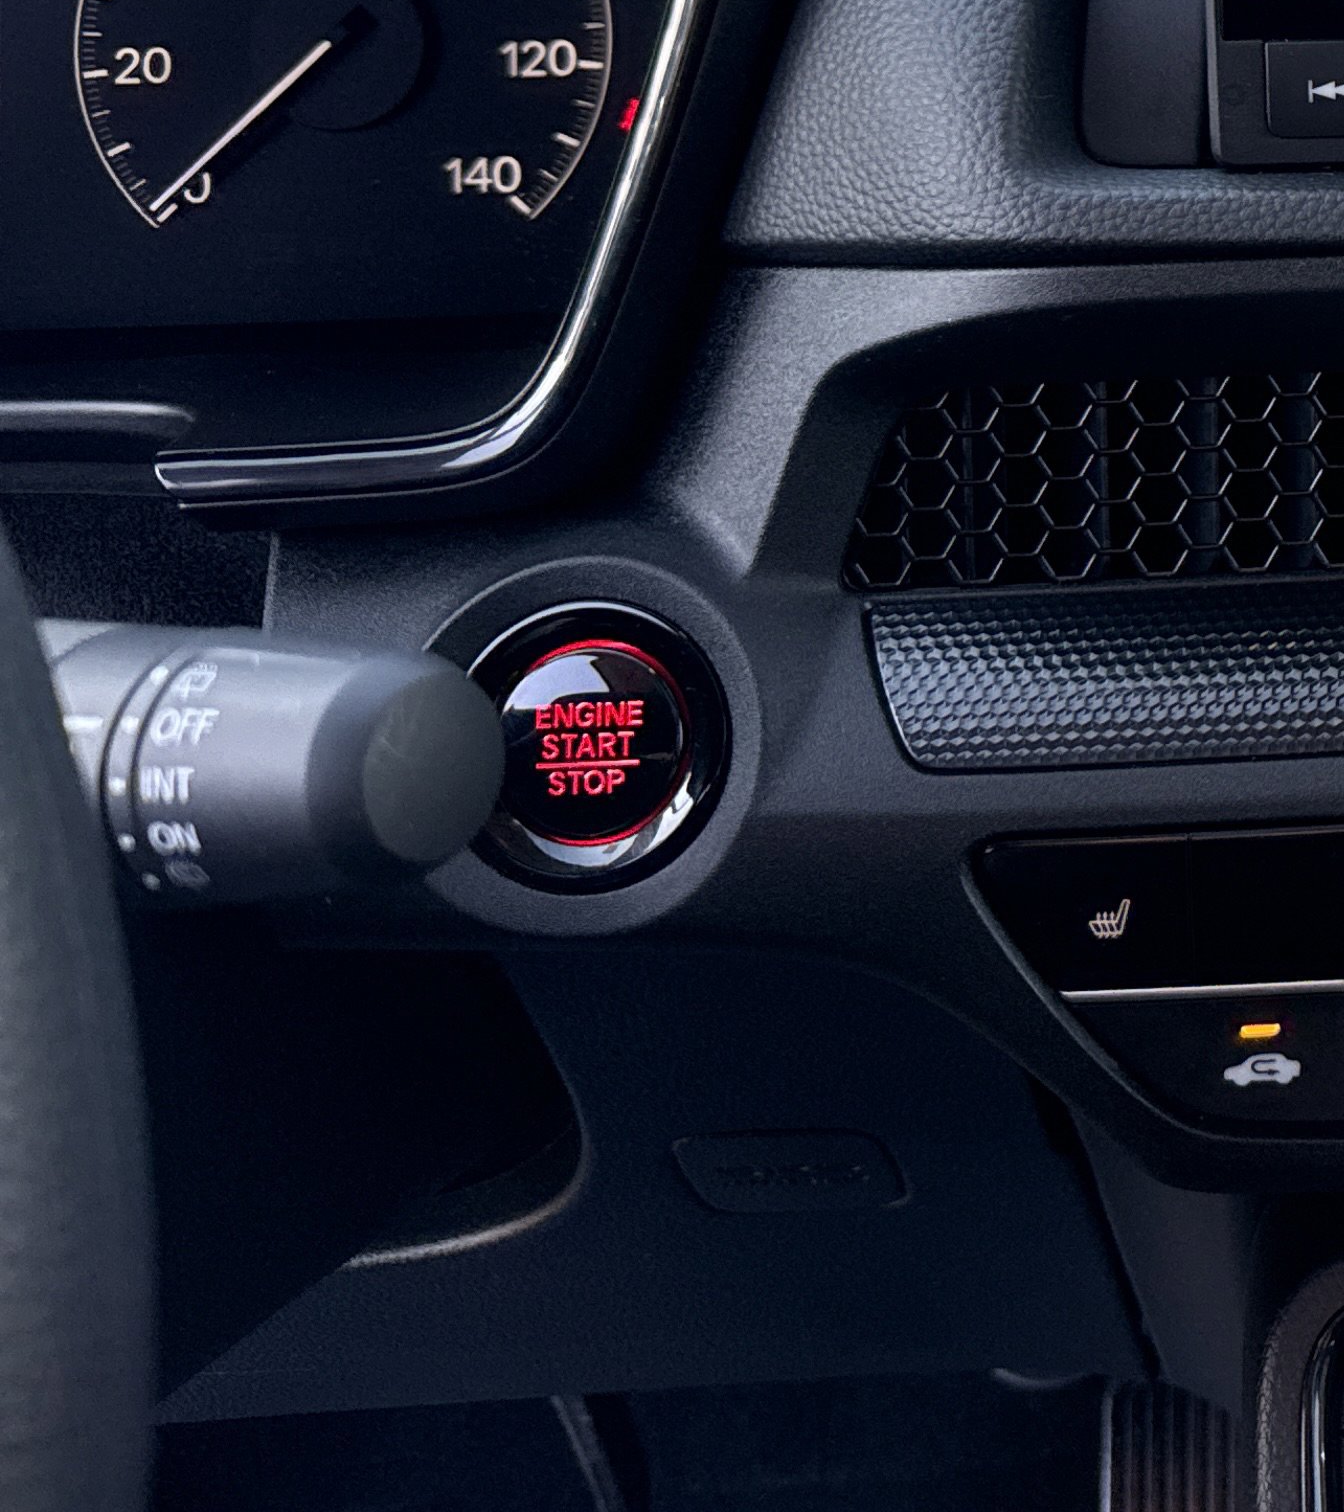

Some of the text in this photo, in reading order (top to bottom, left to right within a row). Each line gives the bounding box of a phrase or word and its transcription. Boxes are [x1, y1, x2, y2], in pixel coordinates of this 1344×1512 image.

[114, 47, 172, 85] 20
[501, 39, 577, 77] 120
[446, 155, 521, 194] 140
[149, 707, 220, 747] OFF
[535, 700, 644, 729] ENGINE
[541, 731, 635, 759] START
[140, 764, 196, 801] INT
[547, 769, 626, 796] STOP
[148, 821, 200, 851] ON
